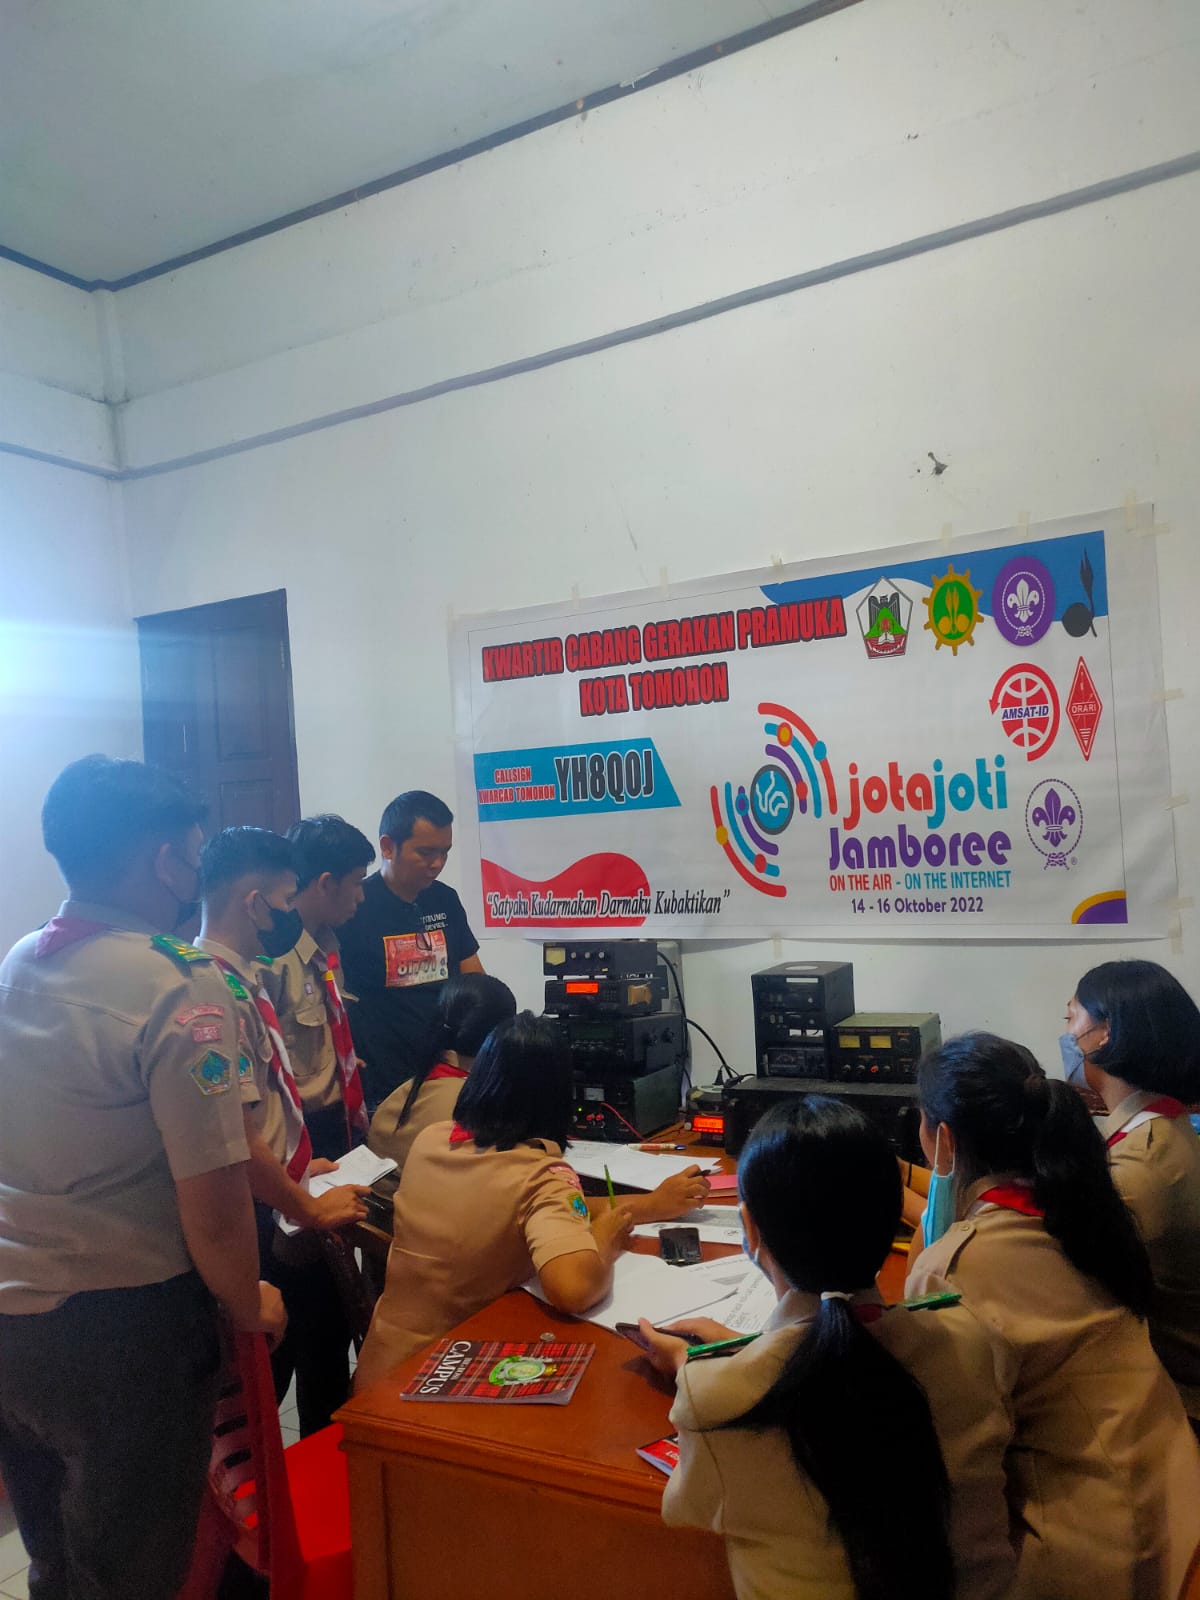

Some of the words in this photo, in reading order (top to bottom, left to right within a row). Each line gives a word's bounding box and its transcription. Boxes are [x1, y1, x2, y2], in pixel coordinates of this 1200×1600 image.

[482, 637, 564, 682] KWARTIR
[565, 626, 641, 671] CABANG
[643, 611, 735, 662] GERAKAN
[737, 597, 848, 650] PRAMUKA
[579, 674, 629, 717] KOTA
[628, 662, 729, 711] TOMOHON
[1002, 705, 1049, 720] AMSAT-ID
[1071, 703, 1096, 713] ORARI
[494, 767, 531, 784] CALLSIGN
[479, 788, 513, 804] KWARCAB
[516, 785, 555, 802] TOMOHON
[843, 754, 1008, 830] jotajoti
[829, 824, 1011, 870] Jamboree
[830, 874, 845, 891] ON
[848, 874, 871, 891] THE
[873, 873, 892, 890] AIR
[904, 873, 921, 889] ON
[923, 872, 948, 889] THE
[951, 871, 1011, 889] INTERNET
[531, 891, 598, 917] Kudarmakan
[600, 892, 650, 916] Darmaku
[852, 899, 865, 914] 14
[878, 899, 891, 913] 16
[895, 897, 947, 914] Oktober
[951, 897, 984, 913] 2022
[420, 1341, 472, 1394] CAMPUS
